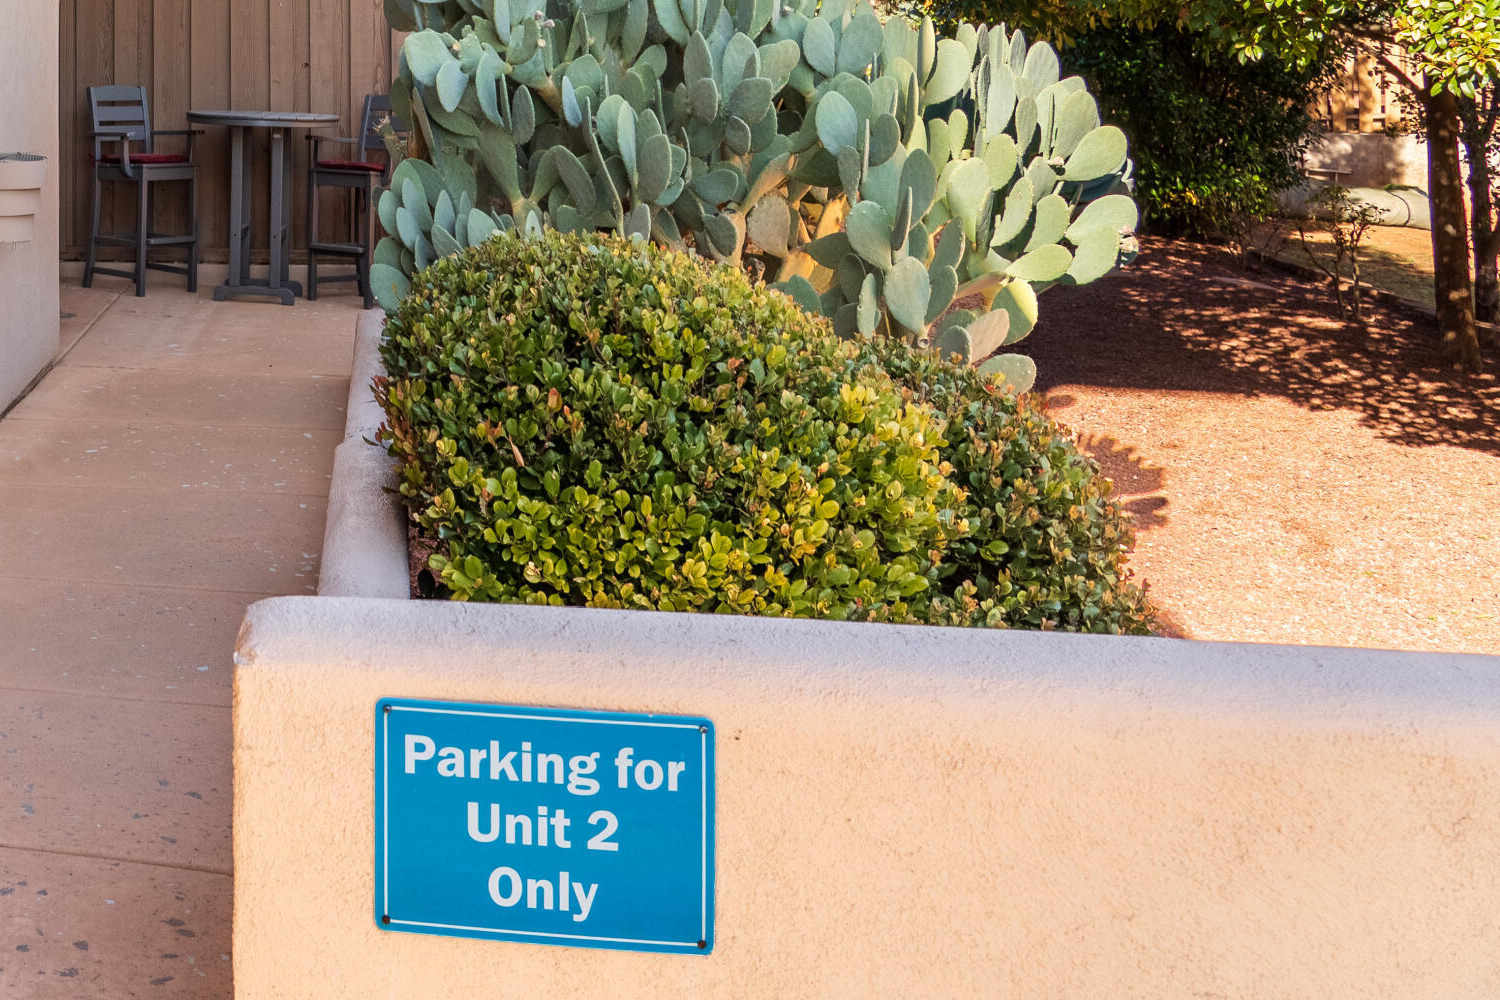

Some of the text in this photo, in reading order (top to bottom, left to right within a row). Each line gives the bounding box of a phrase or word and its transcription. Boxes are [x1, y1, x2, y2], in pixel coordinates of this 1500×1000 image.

[404, 734, 686, 796] Parking for
[467, 801, 619, 851] Unit 2
[487, 866, 599, 922] Only
